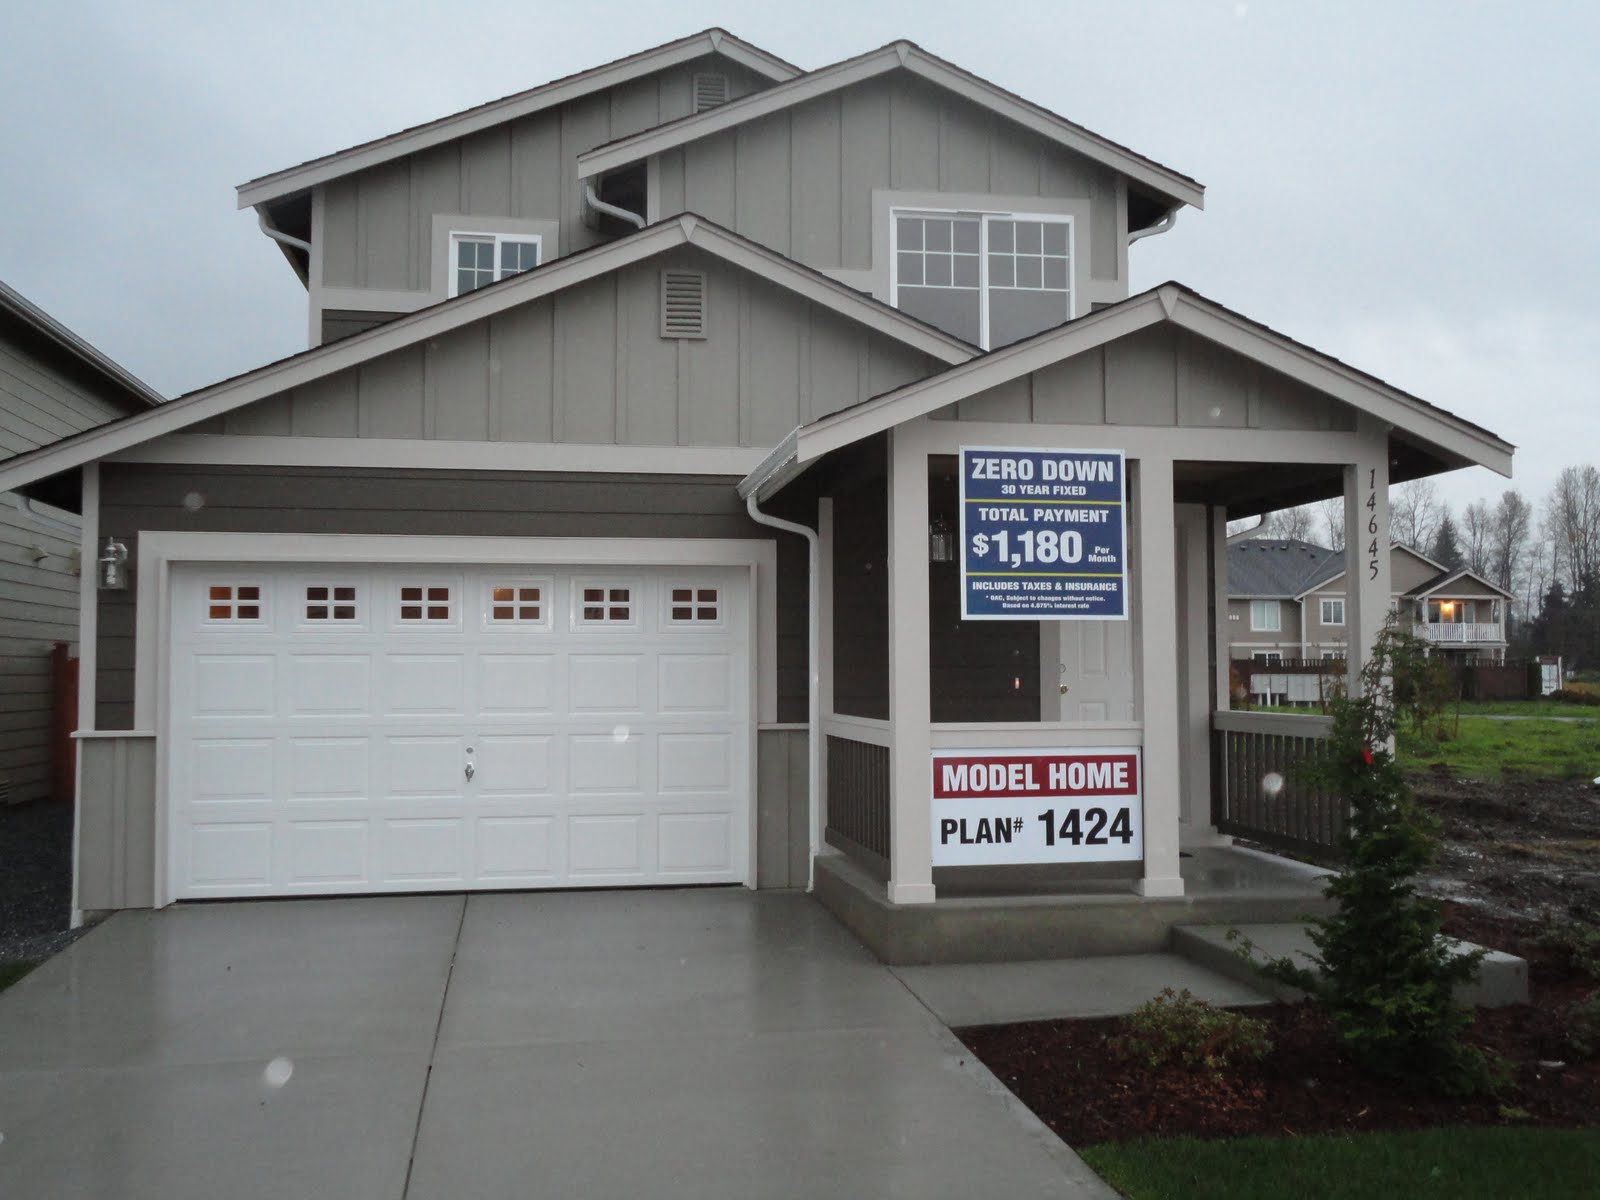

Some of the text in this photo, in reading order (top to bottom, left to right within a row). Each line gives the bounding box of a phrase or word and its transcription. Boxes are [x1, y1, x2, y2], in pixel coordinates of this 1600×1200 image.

[972, 458, 1114, 482] ZERO DOWN
[1001, 485, 1087, 496] 30 YEAR FIXED
[979, 508, 1109, 523] TOTAL PAYMENT
[1366, 468, 1379, 581] 14645
[972, 530, 1083, 568] $1,180
[1088, 554, 1116, 563] Month
[1094, 546, 1110, 555] Per
[972, 581, 1118, 592] INCLUDES TAXES & INSURANCE
[942, 761, 1129, 792] MODEL HOME
[940, 807, 1134, 846] PLAN# 1424
